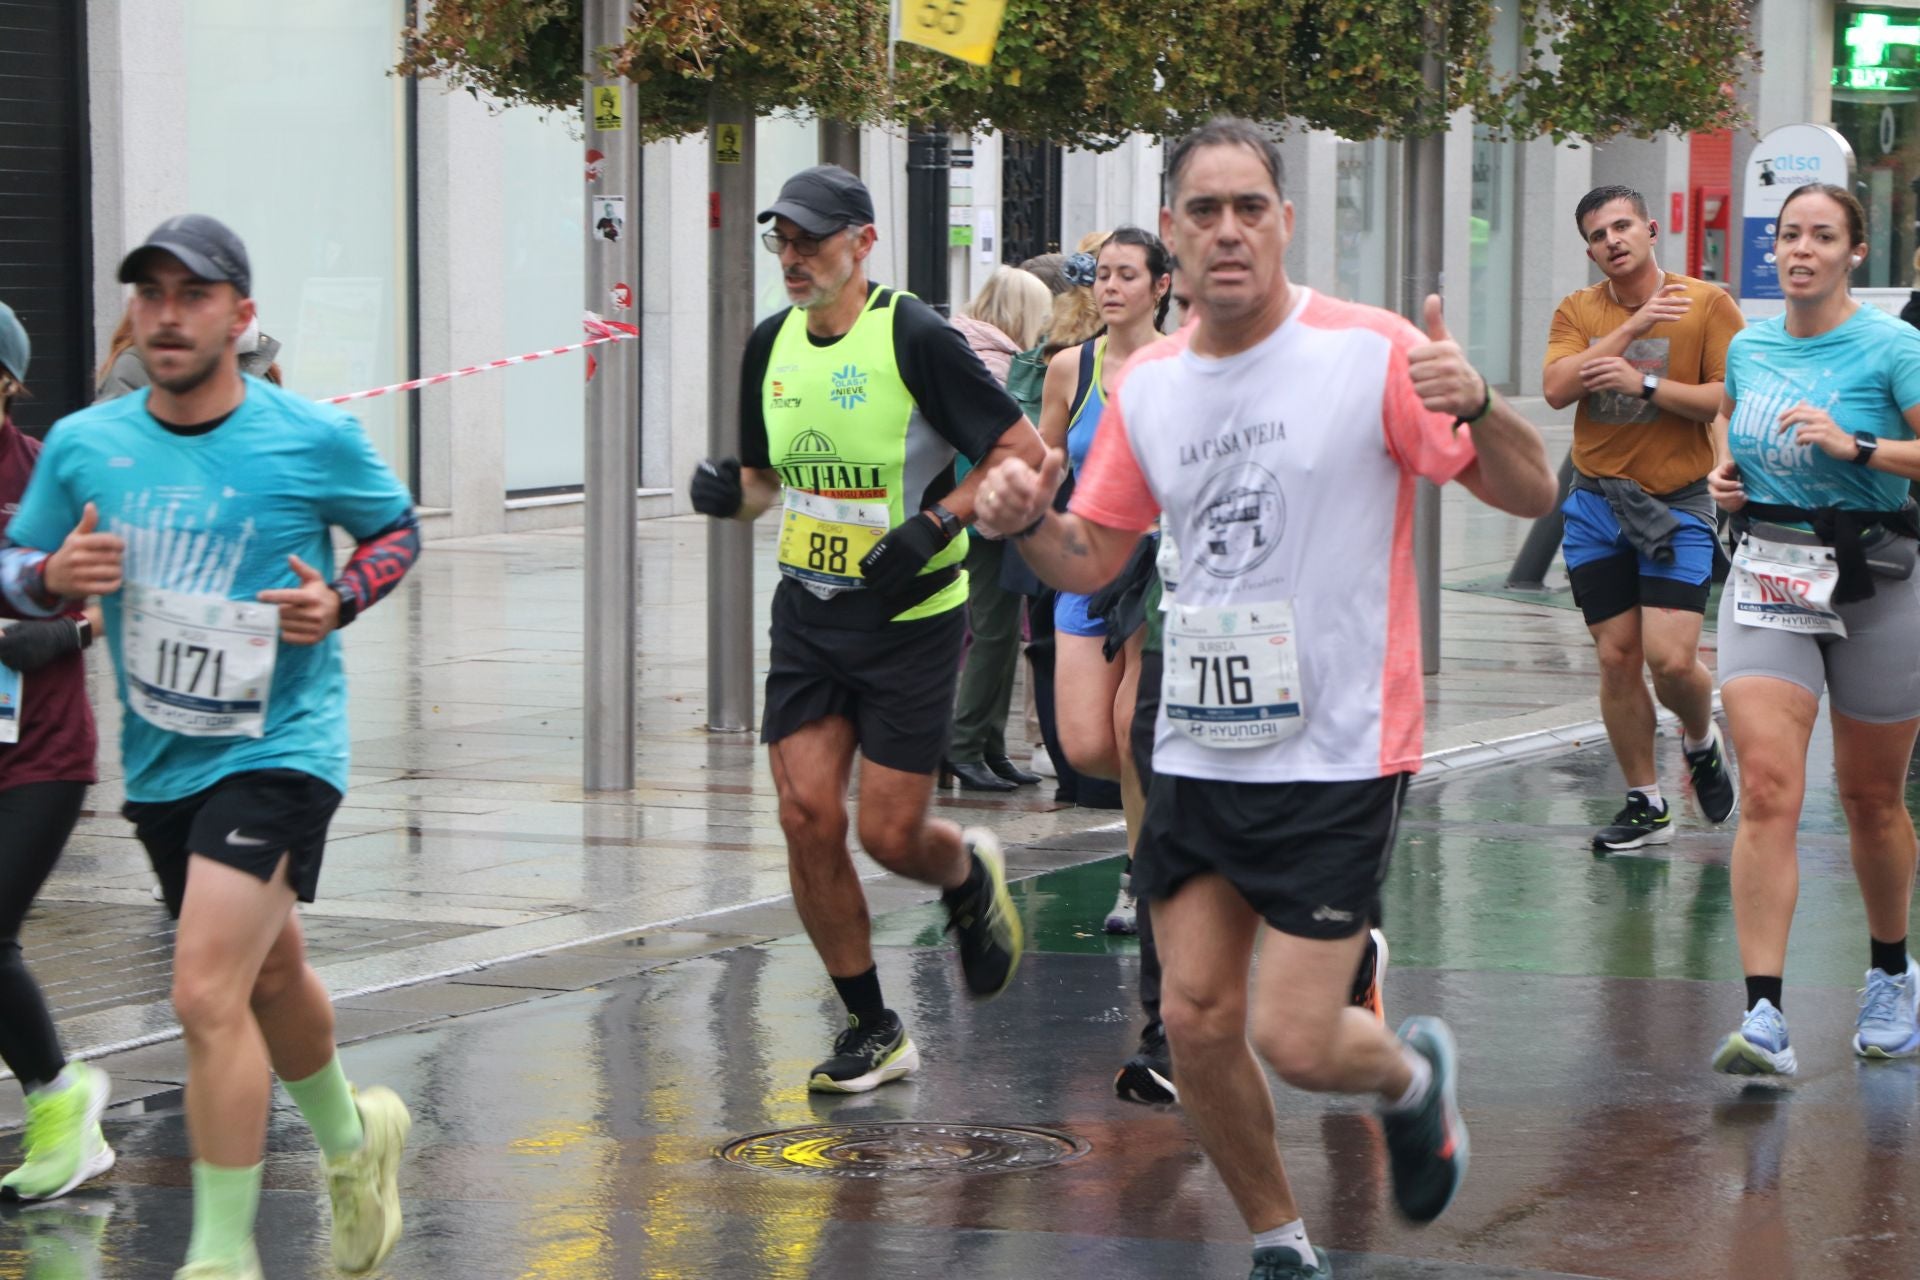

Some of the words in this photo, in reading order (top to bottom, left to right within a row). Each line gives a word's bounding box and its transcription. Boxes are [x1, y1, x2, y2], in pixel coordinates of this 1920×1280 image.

[1775, 155, 1822, 170] alsa
[836, 386, 864, 395] NIEVE
[1179, 444, 1199, 466] LA
[1202, 432, 1241, 460] CASA
[1243, 421, 1286, 448] VIEJA
[808, 531, 848, 574] 88
[157, 638, 224, 697] 1171
[1189, 655, 1254, 706] 716
[1208, 722, 1278, 738] HYUNDAI
